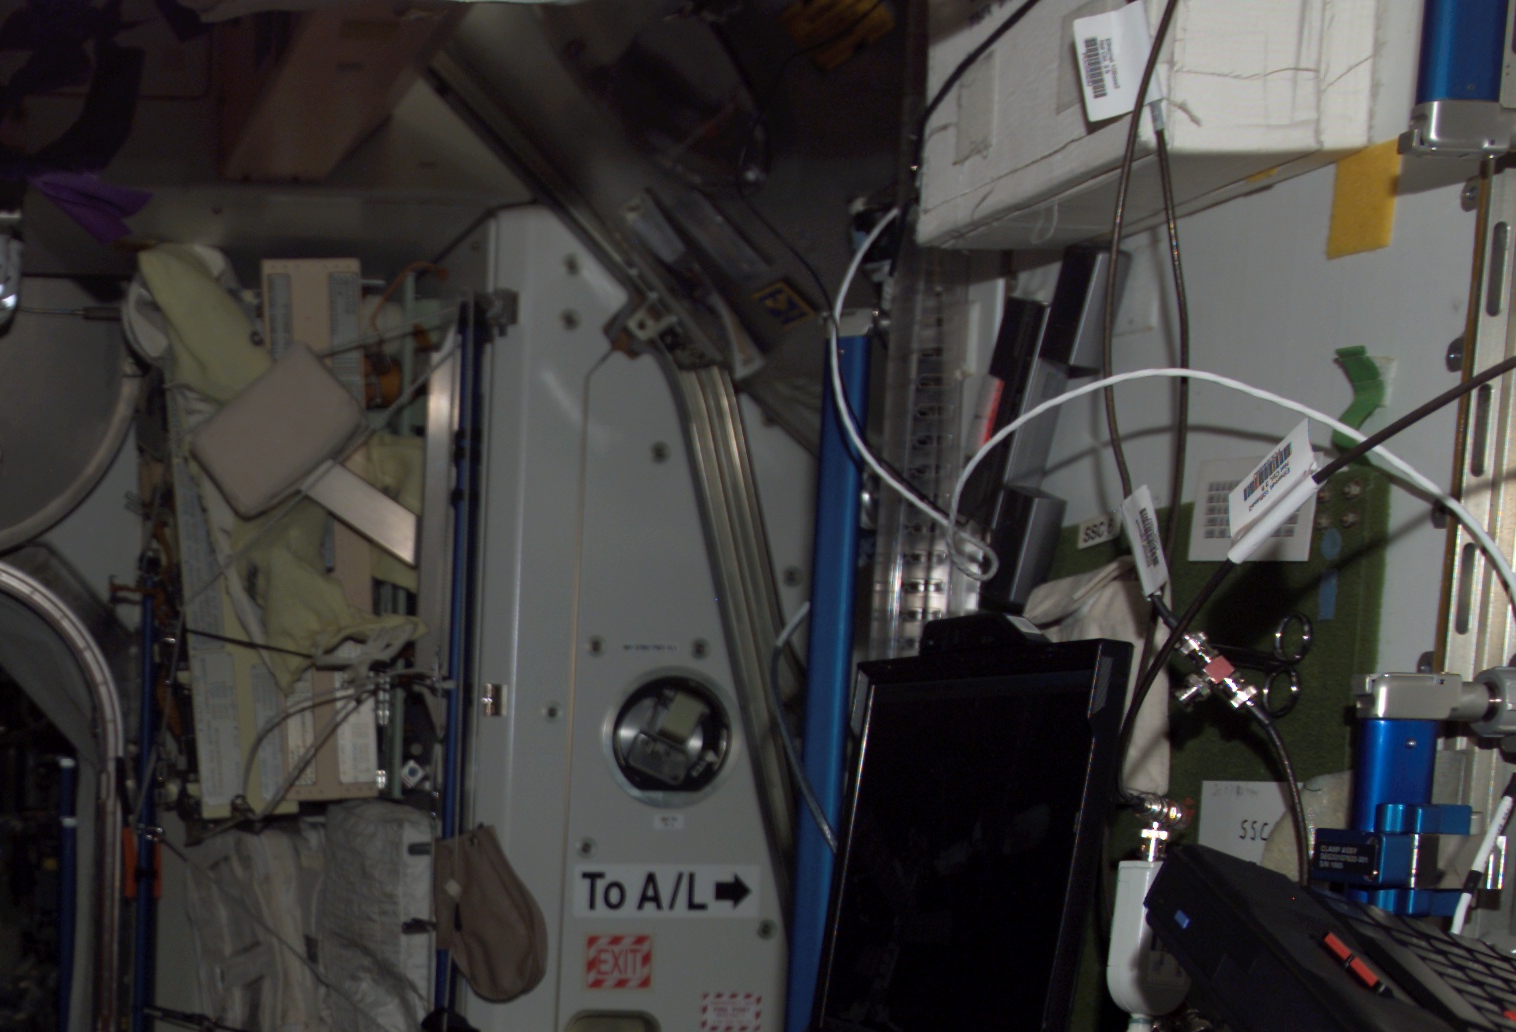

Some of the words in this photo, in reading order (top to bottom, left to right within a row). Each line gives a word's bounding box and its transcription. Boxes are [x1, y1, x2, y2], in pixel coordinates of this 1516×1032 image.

[1239, 819, 1269, 841] SSC
[582, 872, 626, 910] To
[637, 872, 708, 910] A/L
[597, 949, 641, 976] EXIT
